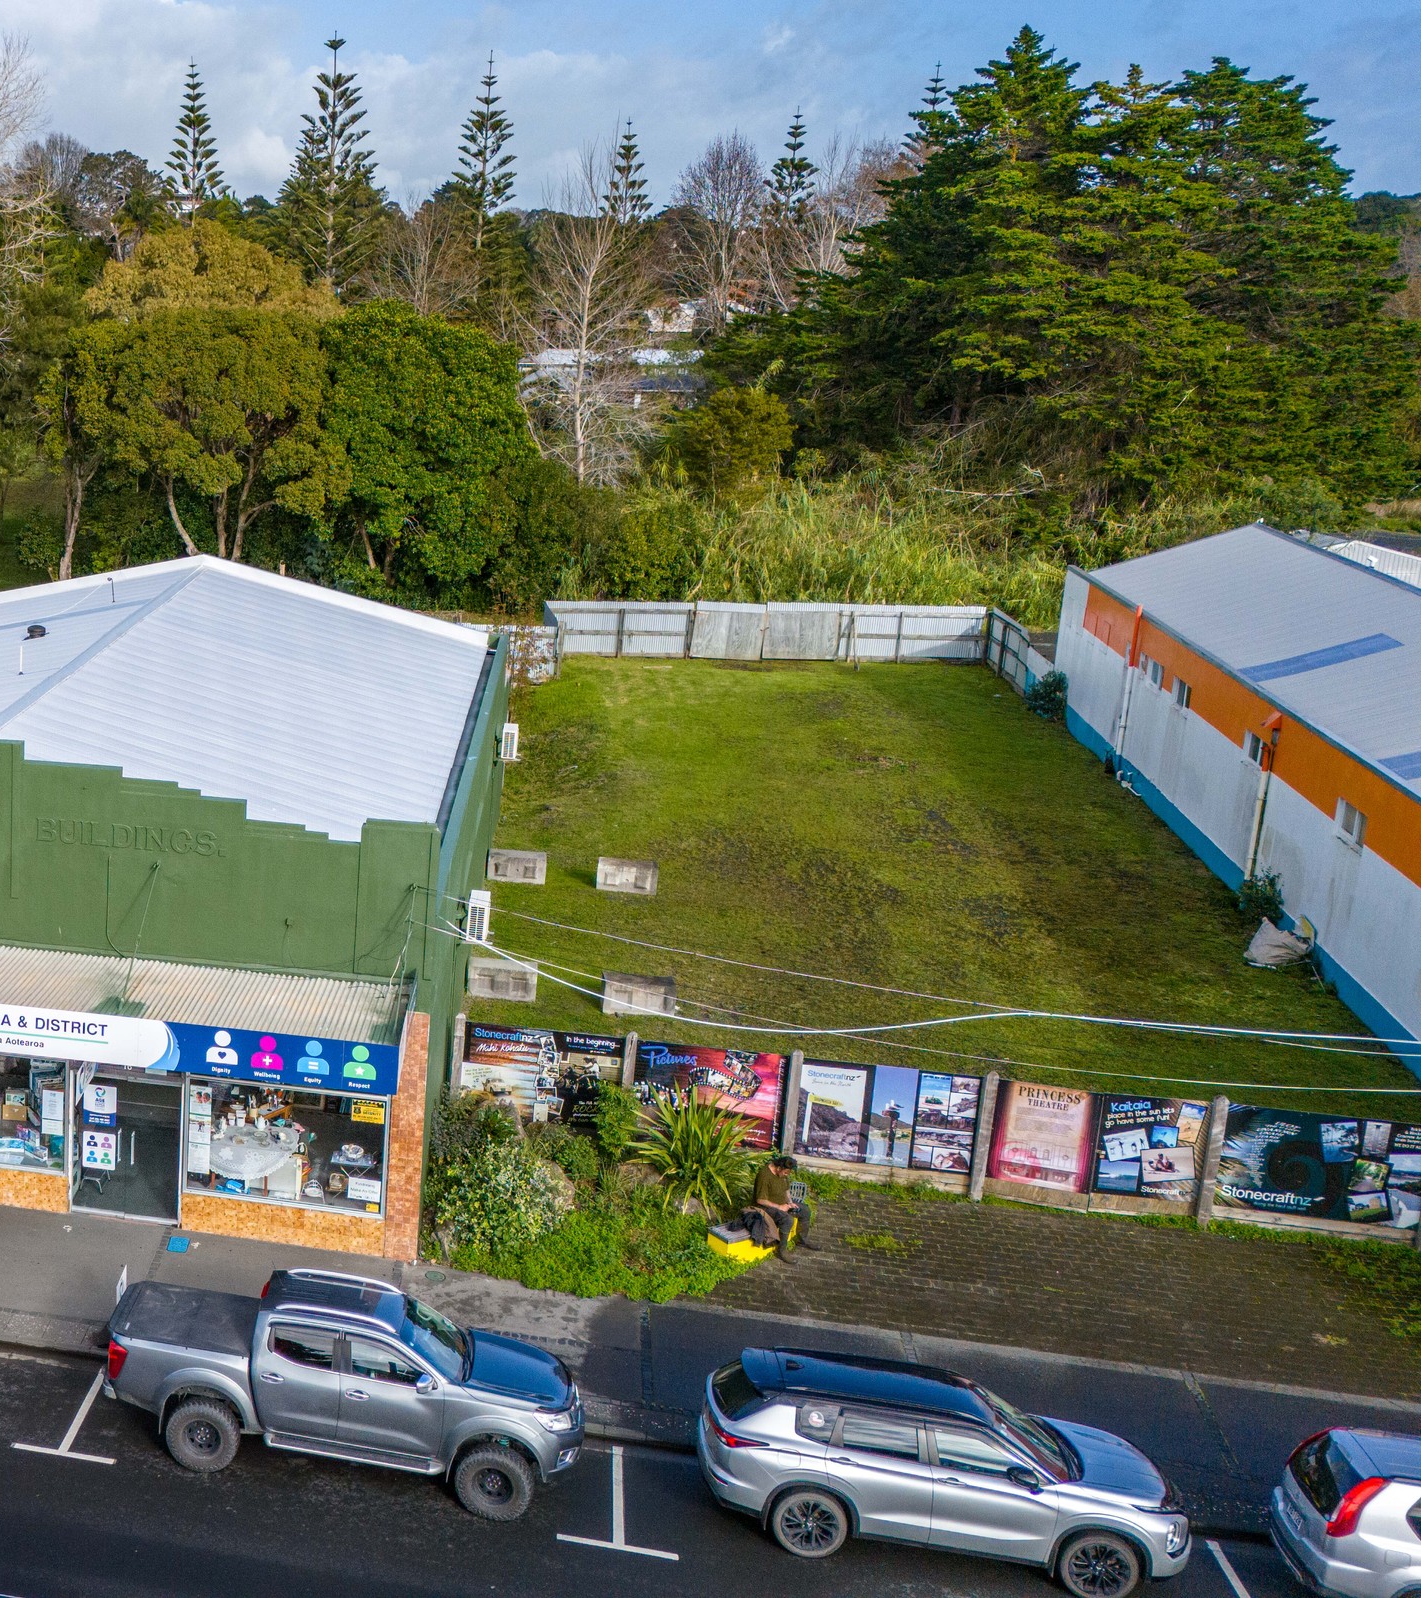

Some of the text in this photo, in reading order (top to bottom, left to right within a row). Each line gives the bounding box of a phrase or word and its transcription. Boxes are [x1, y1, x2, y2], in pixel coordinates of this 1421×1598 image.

[36, 817, 226, 857] BUILDINGS.
[17, 1015, 28, 1028] &
[35, 1017, 108, 1036] DISTRICT
[474, 1027, 534, 1043] Stonecraftnz
[5, 1037, 45, 1048] Aotearoa
[640, 1045, 699, 1068] Pictures
[211, 1066, 231, 1075] Dignity
[253, 1071, 281, 1080] Wellbeing
[807, 1069, 856, 1081] Stonecraftnz
[304, 1076, 322, 1085] Equity
[348, 1081, 370, 1090] Respect
[1018, 1085, 1081, 1105] PRINCESS
[1028, 1098, 1069, 1112] THEATRE
[1111, 1100, 1151, 1112] Kaitaia
[1107, 1112, 1126, 1120] place
[1135, 1109, 1147, 1117] the
[1105, 1120, 1115, 1129] go
[1136, 1116, 1155, 1124] some
[1221, 1184, 1312, 1207] Stonecraftnz
